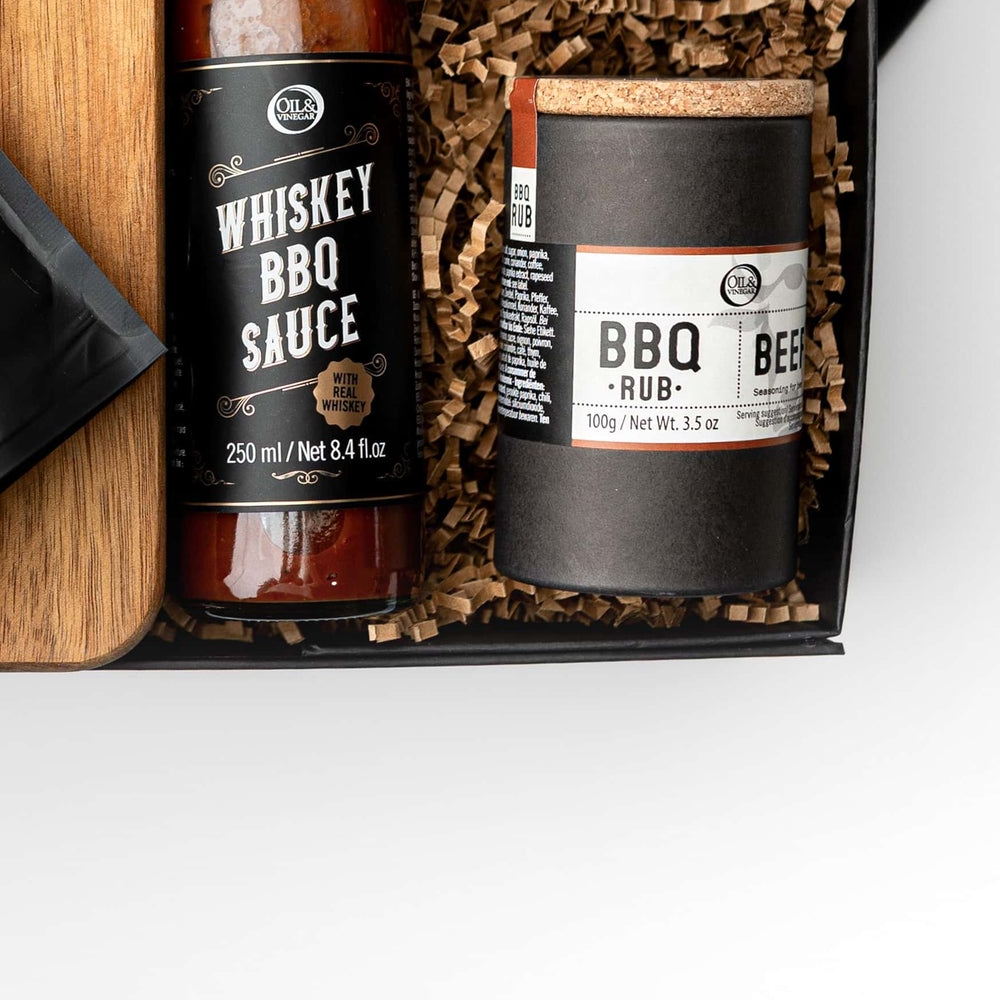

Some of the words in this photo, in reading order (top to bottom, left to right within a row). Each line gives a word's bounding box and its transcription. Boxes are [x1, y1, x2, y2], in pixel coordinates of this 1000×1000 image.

[277, 113, 316, 122] VINEGAR
[514, 183, 529, 202] BBQ
[216, 162, 374, 254] WHISKEY
[512, 203, 532, 228] RUB
[260, 236, 339, 304] BBQ
[241, 294, 360, 372] SAUCE
[600, 320, 701, 373] BBQ
[333, 372, 358, 384] WITH
[333, 386, 358, 398] REAL
[322, 399, 366, 413] WHISKEY
[736, 410, 760, 420] Serving
[586, 414, 617, 434] 100g
[630, 415, 654, 431] Net
[656, 415, 680, 431] Wt.
[683, 415, 702, 431] 3.5
[703, 418, 719, 431] oz
[226, 442, 256, 464] 250
[261, 441, 282, 463] ml
[298, 440, 326, 462] Net
[330, 439, 355, 460] 8.4
